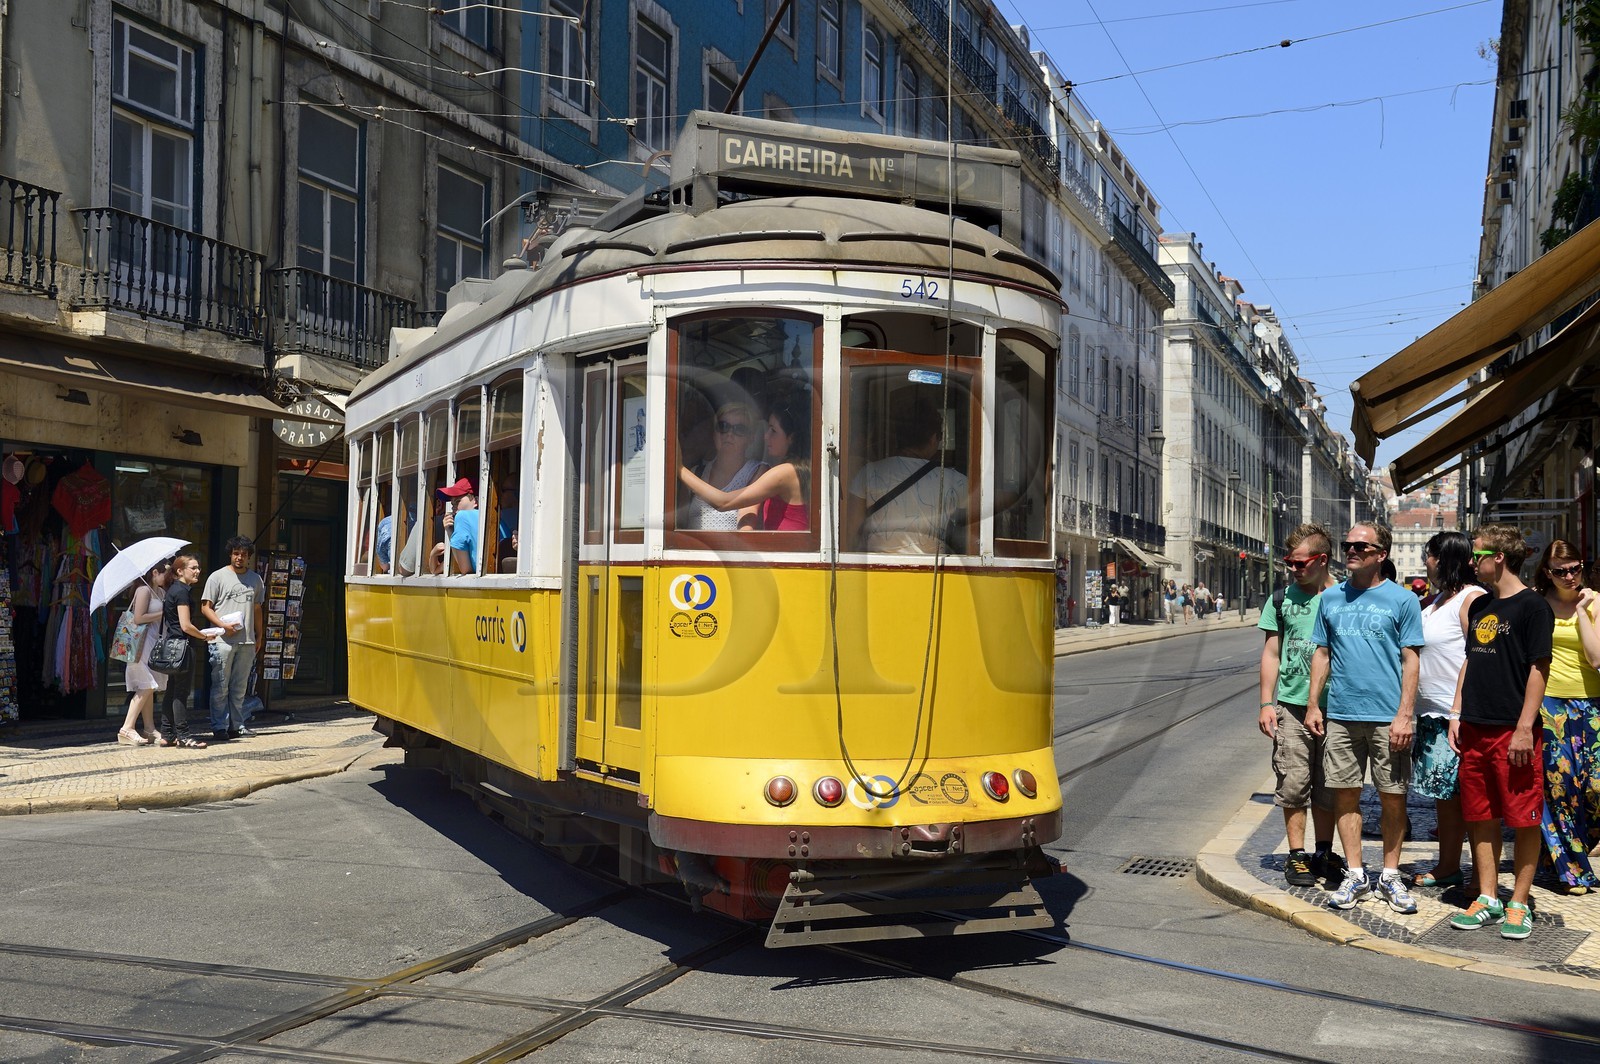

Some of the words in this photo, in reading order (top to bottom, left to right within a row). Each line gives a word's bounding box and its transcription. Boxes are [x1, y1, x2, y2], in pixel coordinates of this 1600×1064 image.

[725, 138, 853, 179] CARREIRA
[900, 279, 939, 300] 542
[279, 427, 327, 445] PRATA
[475, 605, 506, 645] carris
[1337, 612, 1382, 631] 1778
